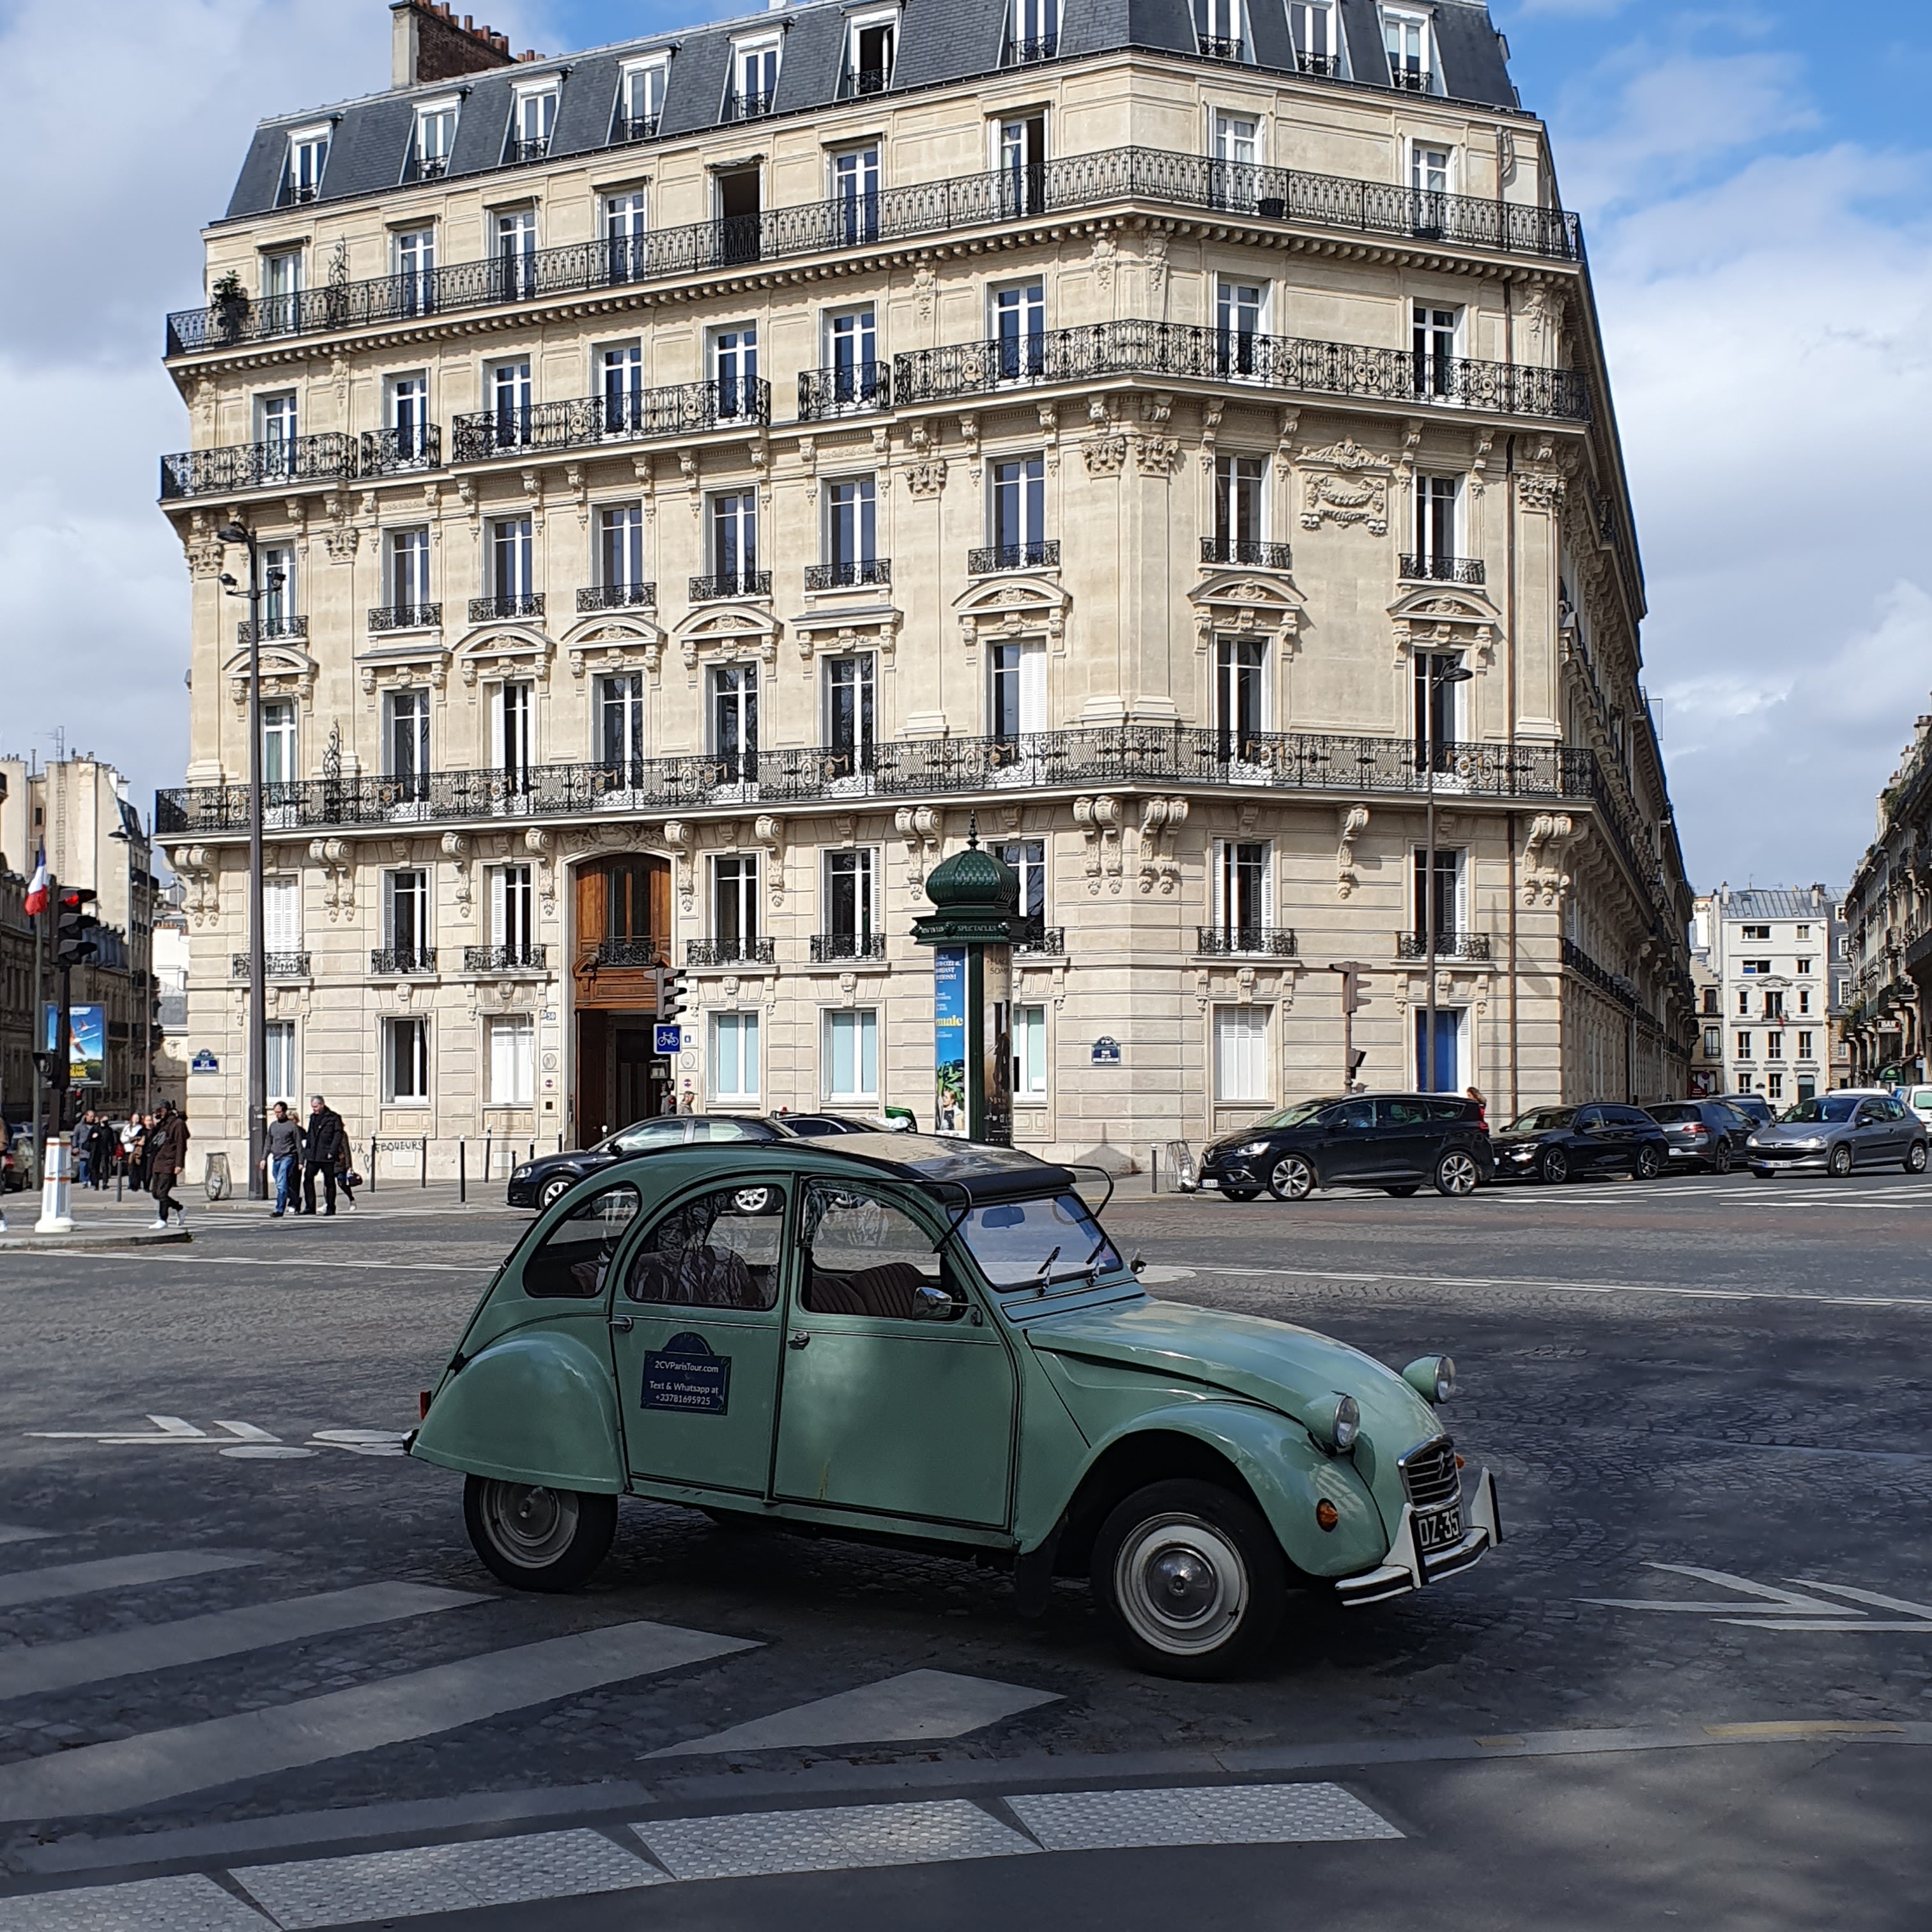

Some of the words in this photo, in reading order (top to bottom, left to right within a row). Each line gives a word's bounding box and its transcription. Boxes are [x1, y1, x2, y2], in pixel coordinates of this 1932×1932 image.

[654, 1360, 719, 1373] 2CVParisTour.com
[649, 1380, 664, 1390] Text
[666, 1382, 672, 1390] &
[673, 1382, 710, 1394] Whatsapp
